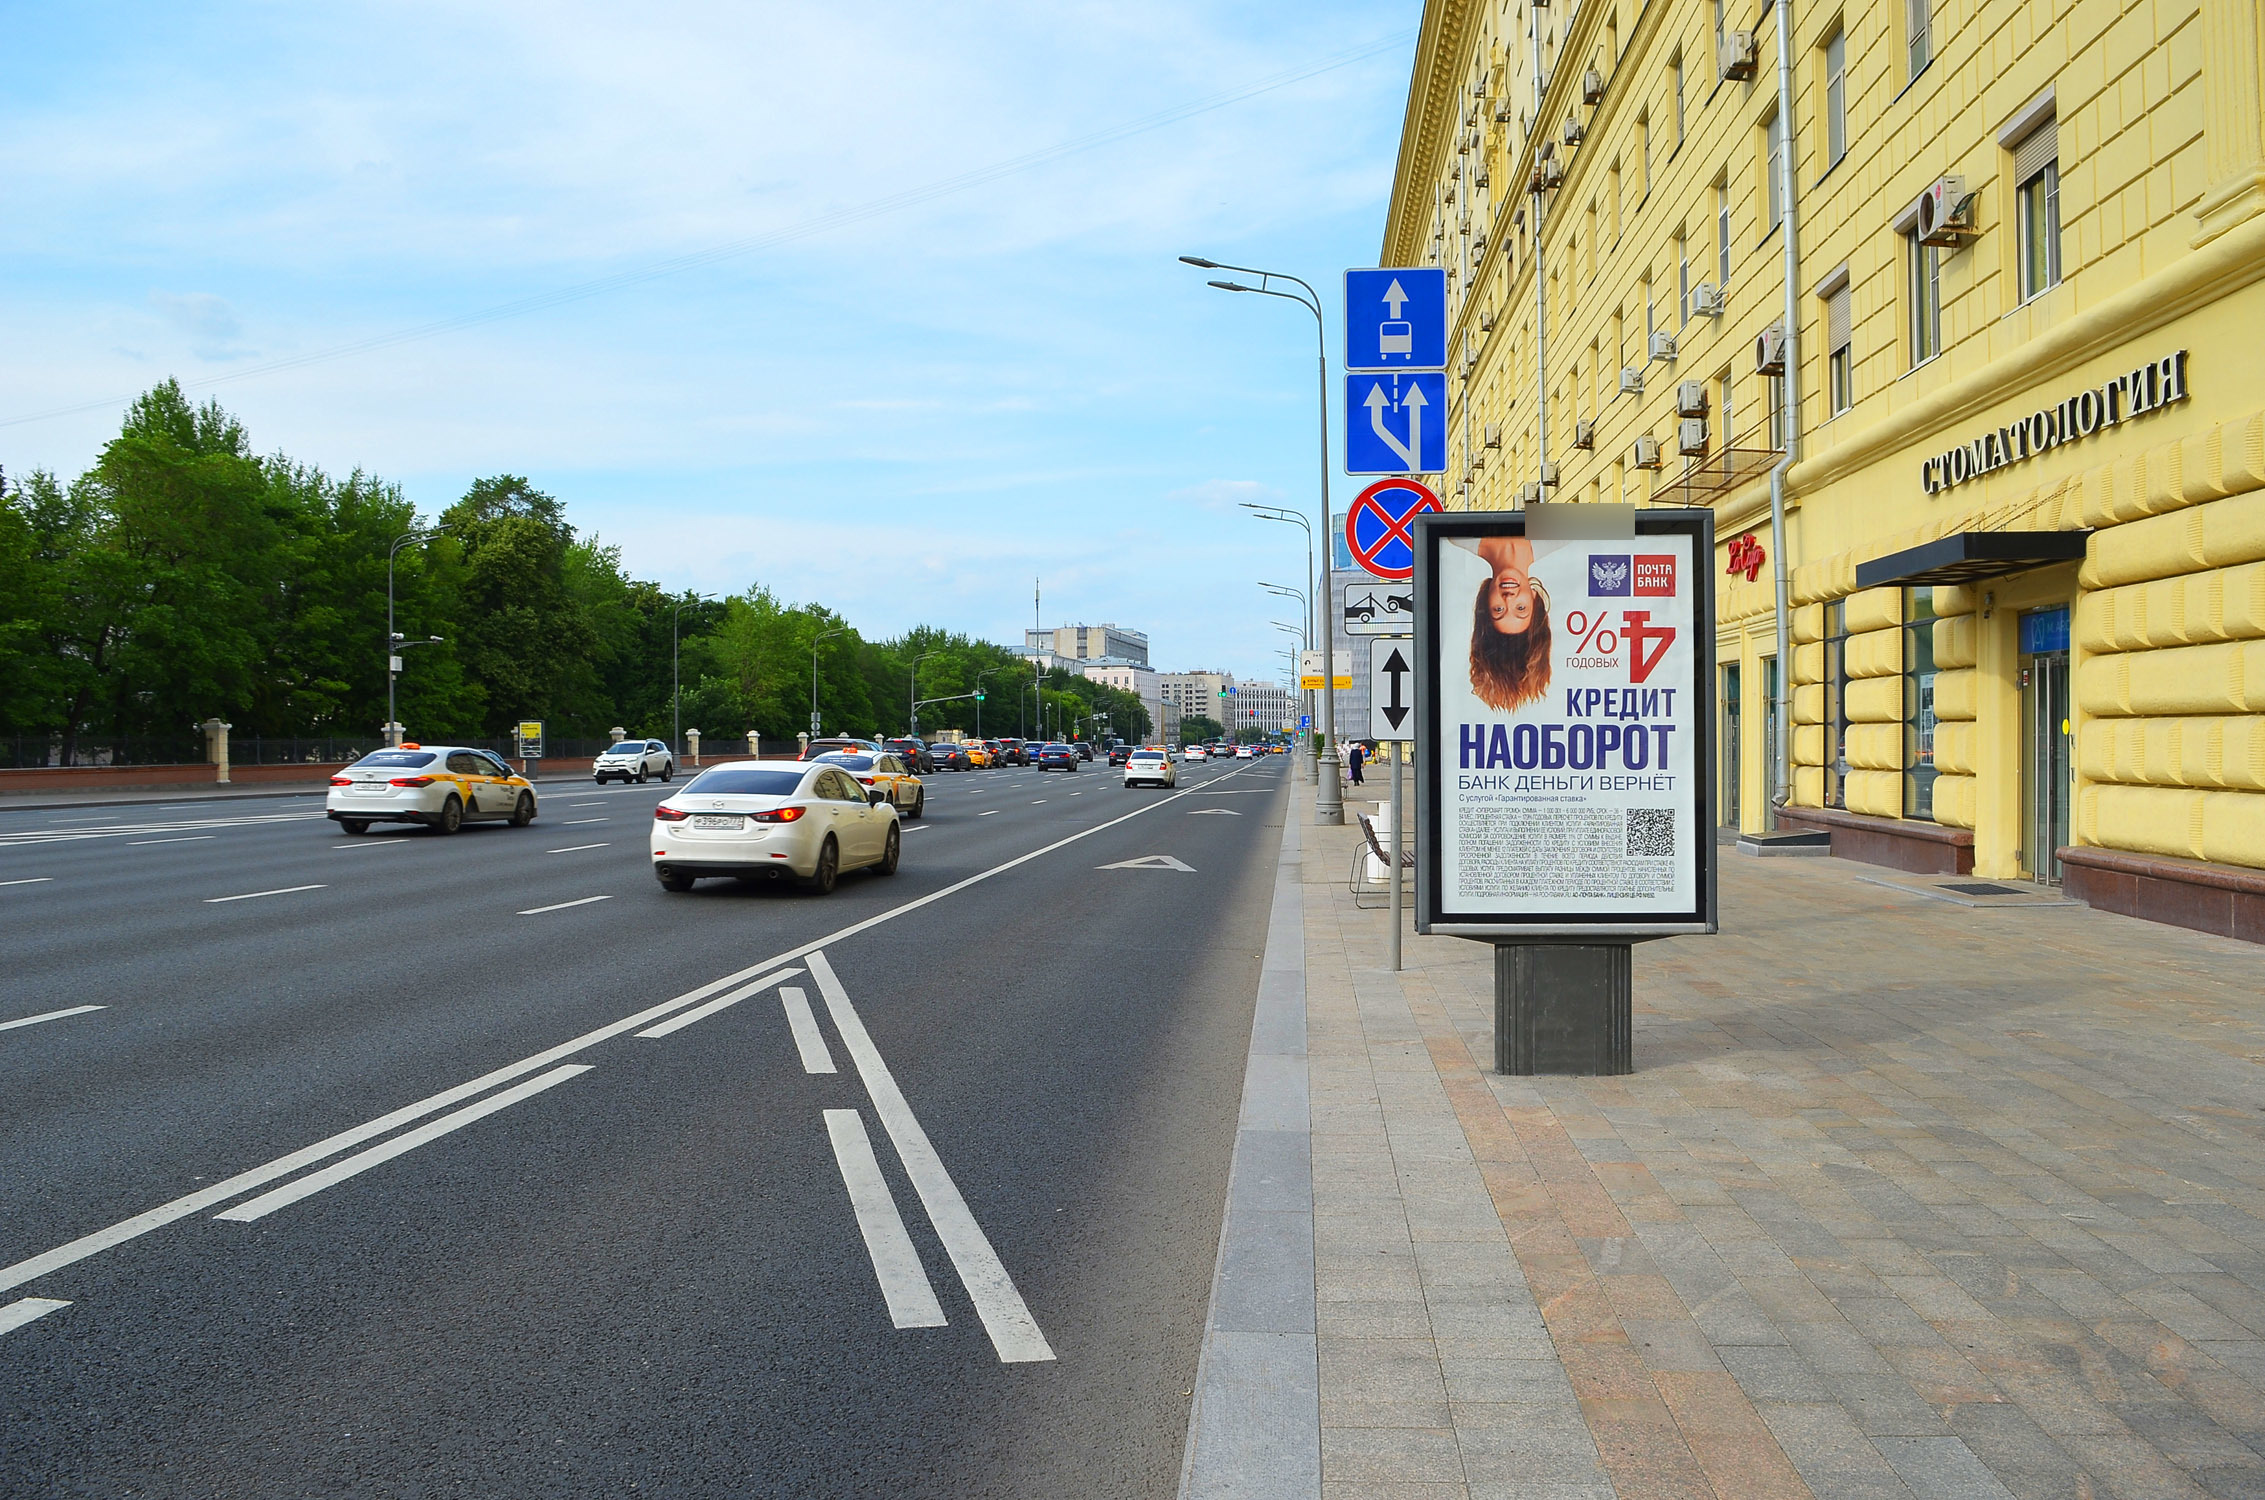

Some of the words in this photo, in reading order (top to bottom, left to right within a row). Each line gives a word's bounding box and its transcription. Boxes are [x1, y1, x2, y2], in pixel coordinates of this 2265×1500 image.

[1921, 350, 2190, 494] СТОМАТОЛОГИЯ
[1637, 564, 1673, 575] ПОЧТА
[1637, 576, 1669, 588] БАНК
[1566, 610, 1618, 654] %
[1620, 610, 1676, 683] 4
[1566, 657, 1619, 669] ГОДОВЫХ
[1566, 688, 1676, 721] КРЕДИТ
[1459, 723, 1676, 770] НАОБОРОТ
[1459, 775, 1510, 790] БАНК
[1515, 775, 1593, 792] ДЕНЬГИ
[1600, 773, 1676, 790] ВЕРНЁТ
[1458, 794, 1465, 802] С
[1466, 794, 1494, 803] услугой
[1495, 794, 1559, 803] «Гарантированная
